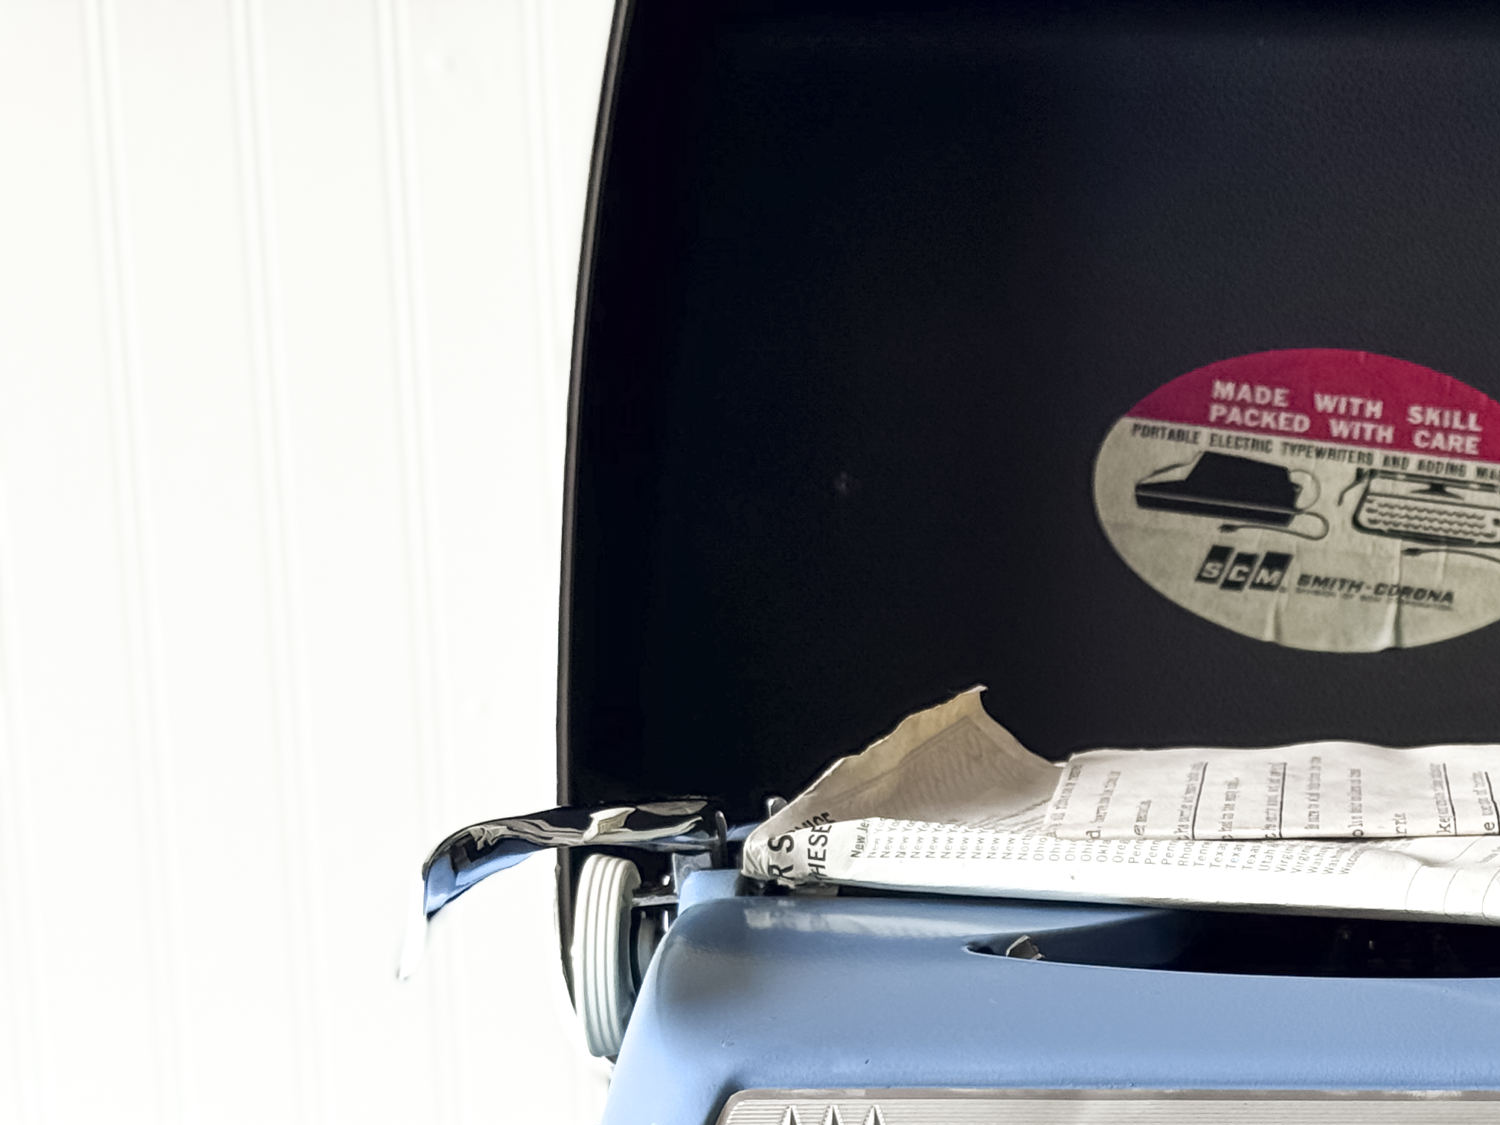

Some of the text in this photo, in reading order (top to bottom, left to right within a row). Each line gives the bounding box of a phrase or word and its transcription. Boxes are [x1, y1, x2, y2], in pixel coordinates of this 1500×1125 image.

[1212, 380, 1482, 432] MADE WITH SKILL
[1208, 402, 1480, 455] PACKED WITH CARE
[1132, 423, 1199, 445] PORTABLE
[1209, 433, 1273, 454] ELECTRIC
[1280, 442, 1374, 466] TYPEWRITERS
[1383, 455, 1409, 471] AND
[1416, 458, 1467, 478] ADDING
[1199, 559, 1284, 587] SCM
[1297, 573, 1454, 604] SMITH-CORONA
[850, 835, 865, 858] New
[880, 836, 894, 858] New
[895, 836, 909, 858] New
[910, 836, 924, 858] New
[925, 836, 939, 858] New
[940, 836, 954, 859] New
[956, 836, 969, 859] New
[971, 837, 985, 859] New
[986, 837, 1000, 859] New
[1002, 837, 1016, 860] New
[1033, 837, 1047, 861] Ohio
